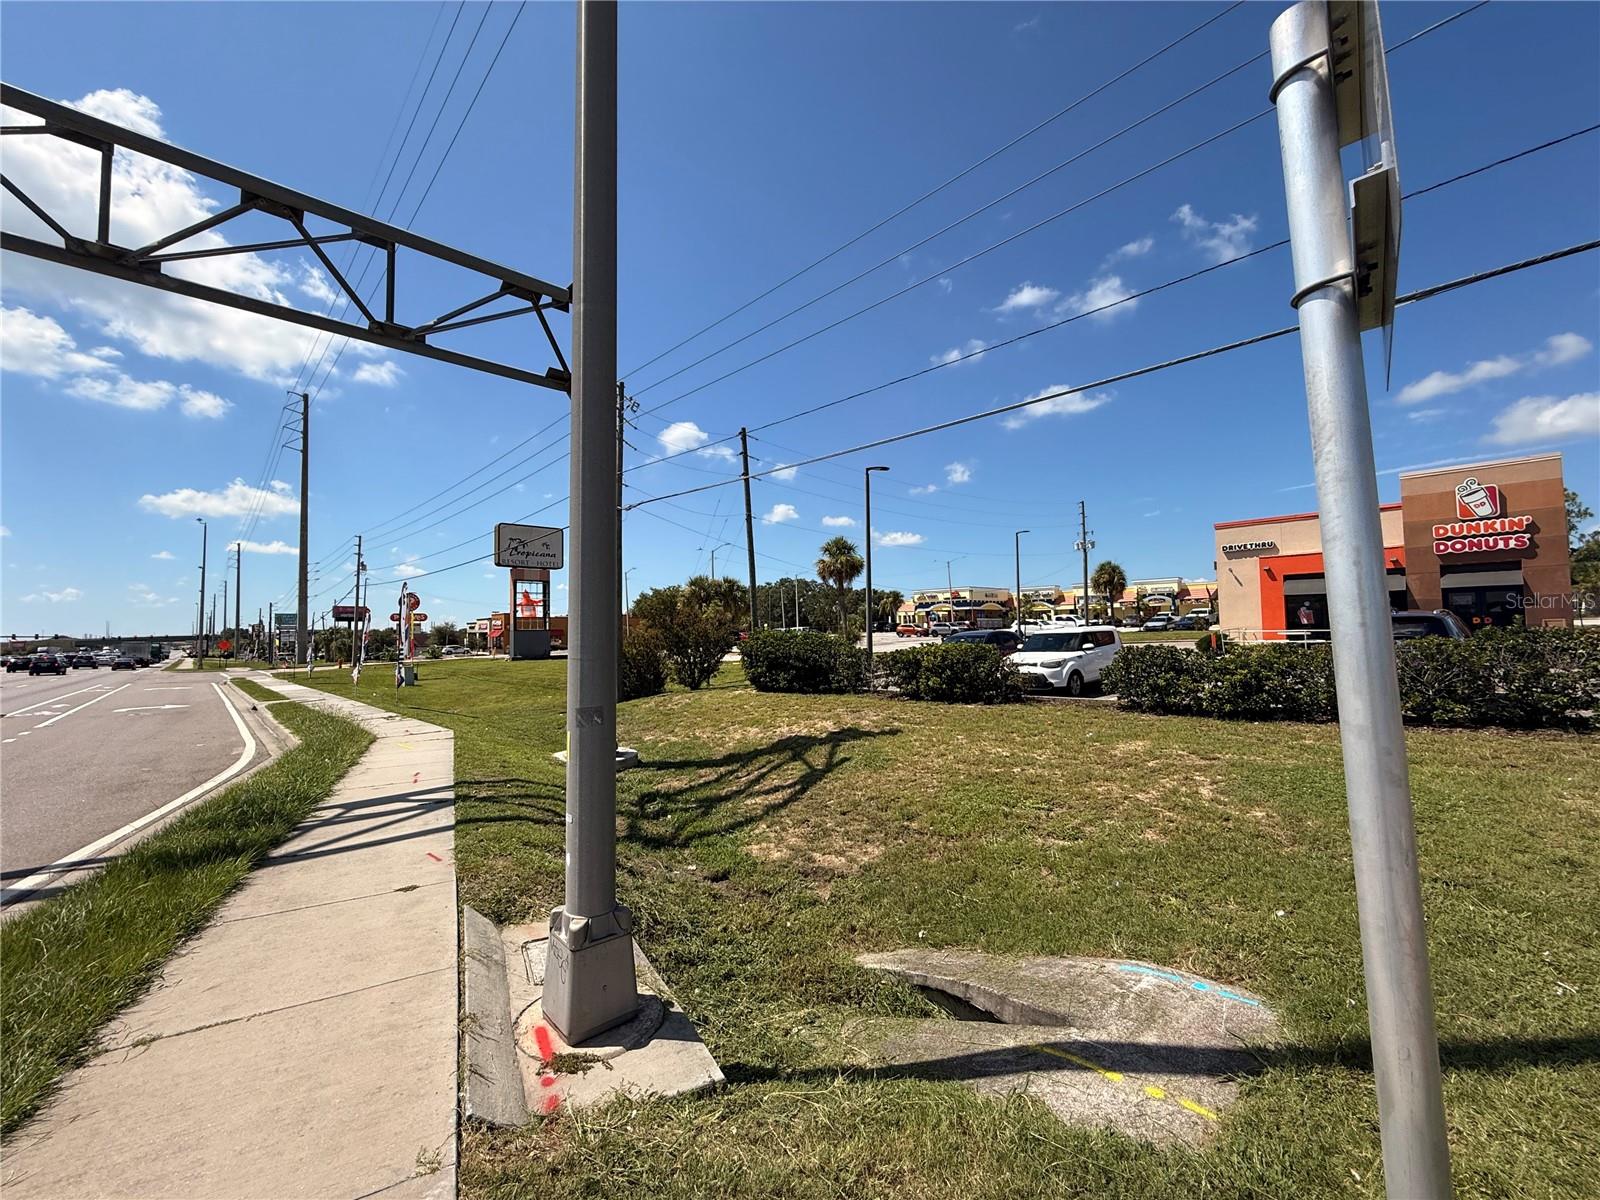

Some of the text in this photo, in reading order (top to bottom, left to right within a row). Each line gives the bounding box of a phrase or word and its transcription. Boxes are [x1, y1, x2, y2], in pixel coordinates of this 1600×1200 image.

[1433, 516, 1532, 538] DUNKIN'
[1221, 541, 1274, 552] DRIVE THRU
[1434, 535, 1528, 554] DONUTS
[509, 548, 557, 559] Tropicana
